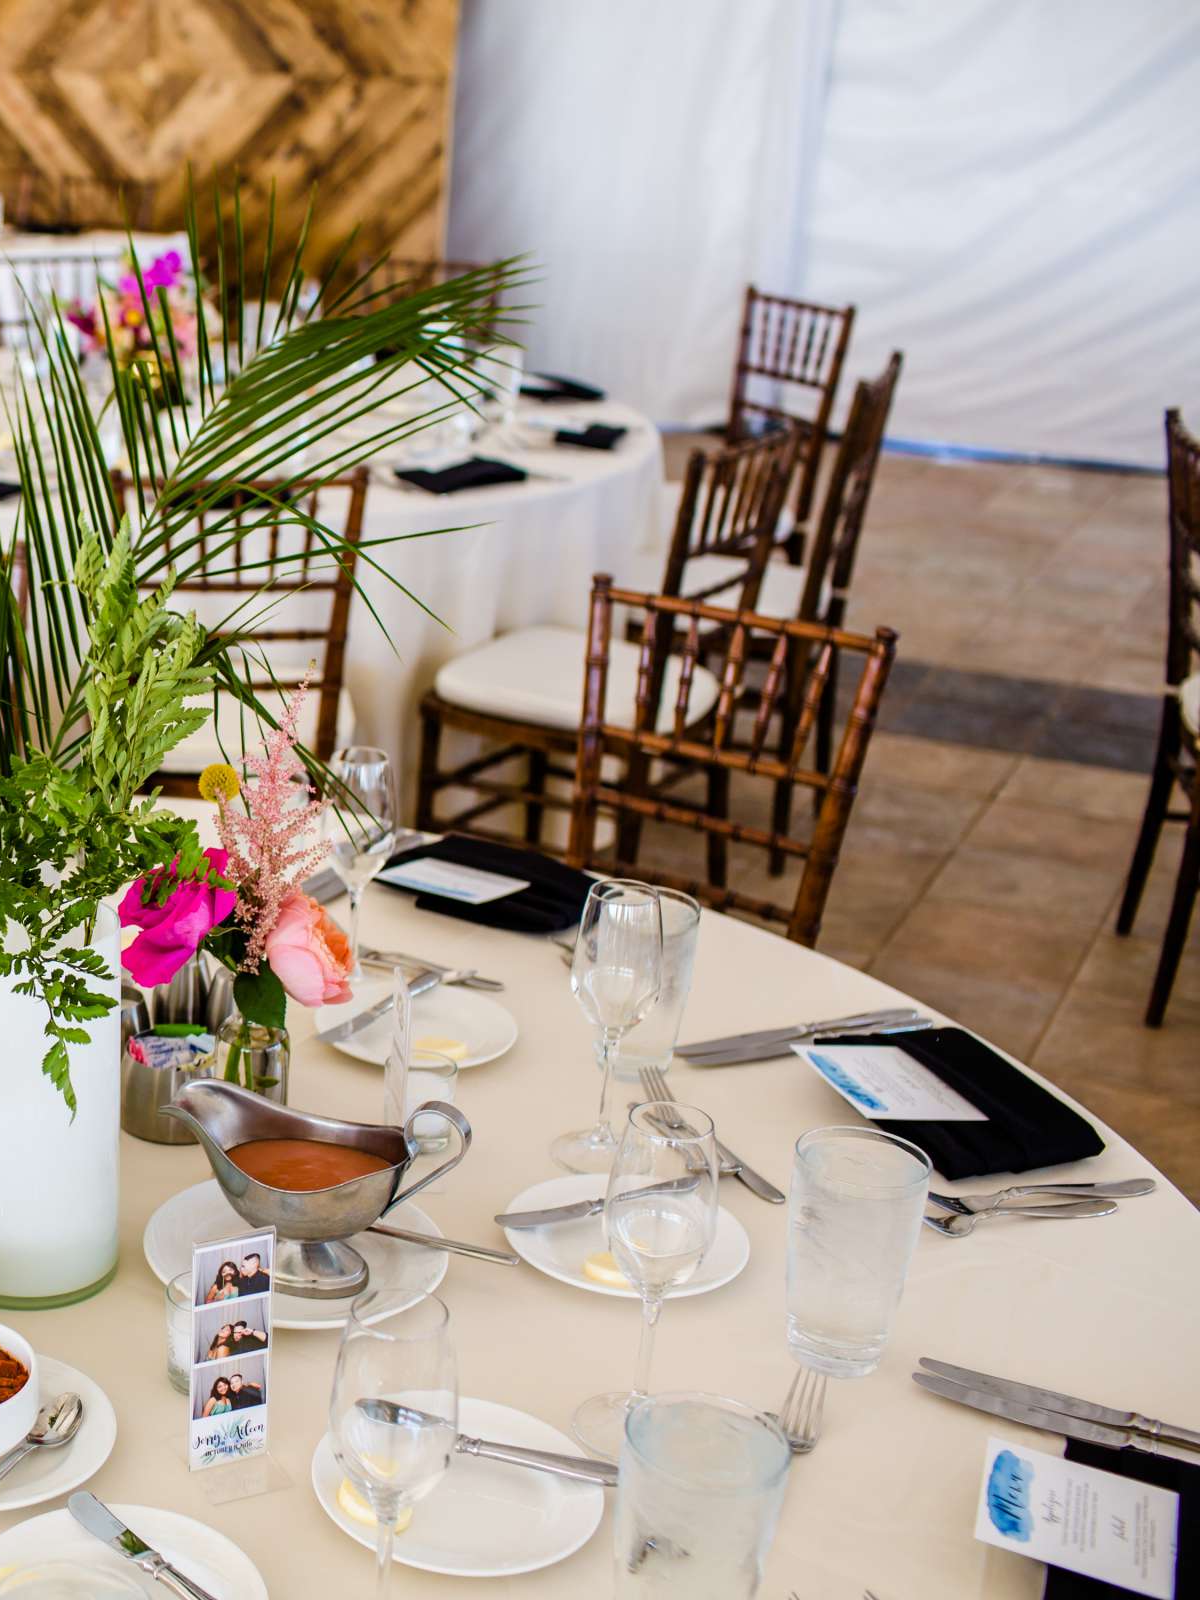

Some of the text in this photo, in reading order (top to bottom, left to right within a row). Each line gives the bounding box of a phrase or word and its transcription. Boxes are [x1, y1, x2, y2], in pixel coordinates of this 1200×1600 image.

[193, 1434, 221, 1449] Jerry
[230, 1419, 264, 1440] Aileen
[992, 1472, 1025, 1520] Menu
